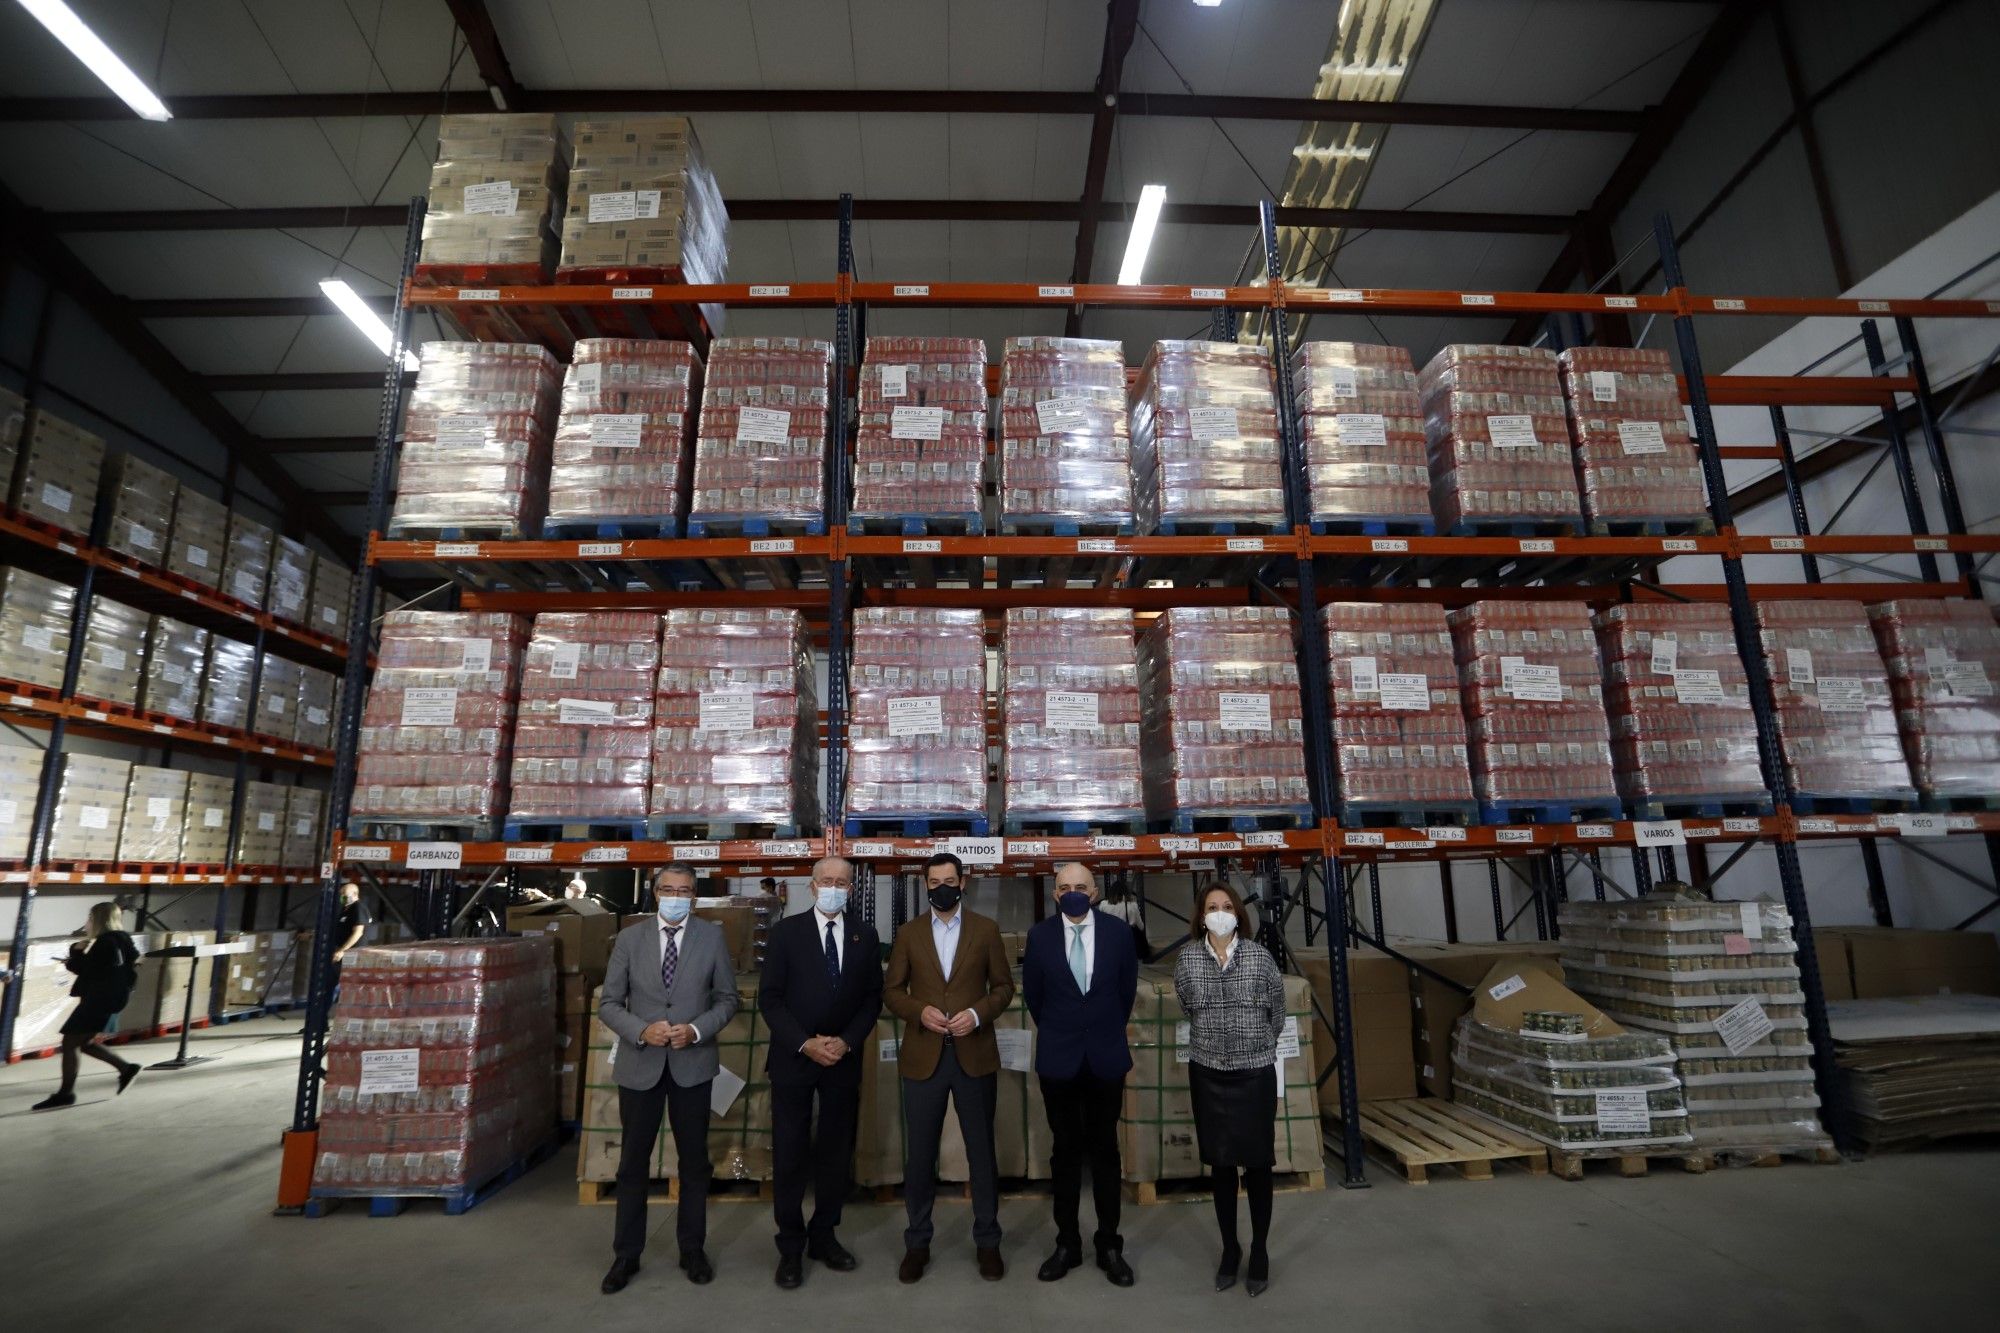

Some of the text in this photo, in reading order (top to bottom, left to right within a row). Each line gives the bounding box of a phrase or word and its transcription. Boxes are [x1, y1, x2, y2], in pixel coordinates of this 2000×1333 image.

[461, 290, 478, 298] BE2
[896, 287, 928, 295] BE2 9-4
[1040, 288, 1073, 296] BE2 8-4
[1192, 289, 1225, 298] BE2 7-4
[753, 541, 793, 550] BE2 10-3
[906, 542, 940, 550] BE2 9-3
[1230, 540, 1246, 549] BE2
[1394, 542, 1408, 550] 6-3
[1522, 542, 1537, 550] BE2
[580, 546, 598, 554] BE2
[1431, 830, 1465, 839] BE2 6-2
[1498, 832, 1514, 840] BE2
[1579, 828, 1595, 836] BE2
[1643, 828, 1674, 839] VARIOS
[1247, 834, 1283, 844] BE2 7-2
[1348, 834, 1382, 843] BE2 6-1
[765, 844, 782, 853] BE2
[937, 844, 949, 853] BE
[1186, 840, 1198, 849] 7-1
[347, 849, 364, 857] BE2
[677, 848, 718, 857] BE2 10-1
[856, 845, 892, 855] BE2 9-1
[956, 846, 996, 855] BATIDOS
[409, 850, 460, 860] GARBANZO
[509, 851, 525, 859] BE2
[585, 851, 600, 859] BE2
[324, 866, 330, 875] 2
